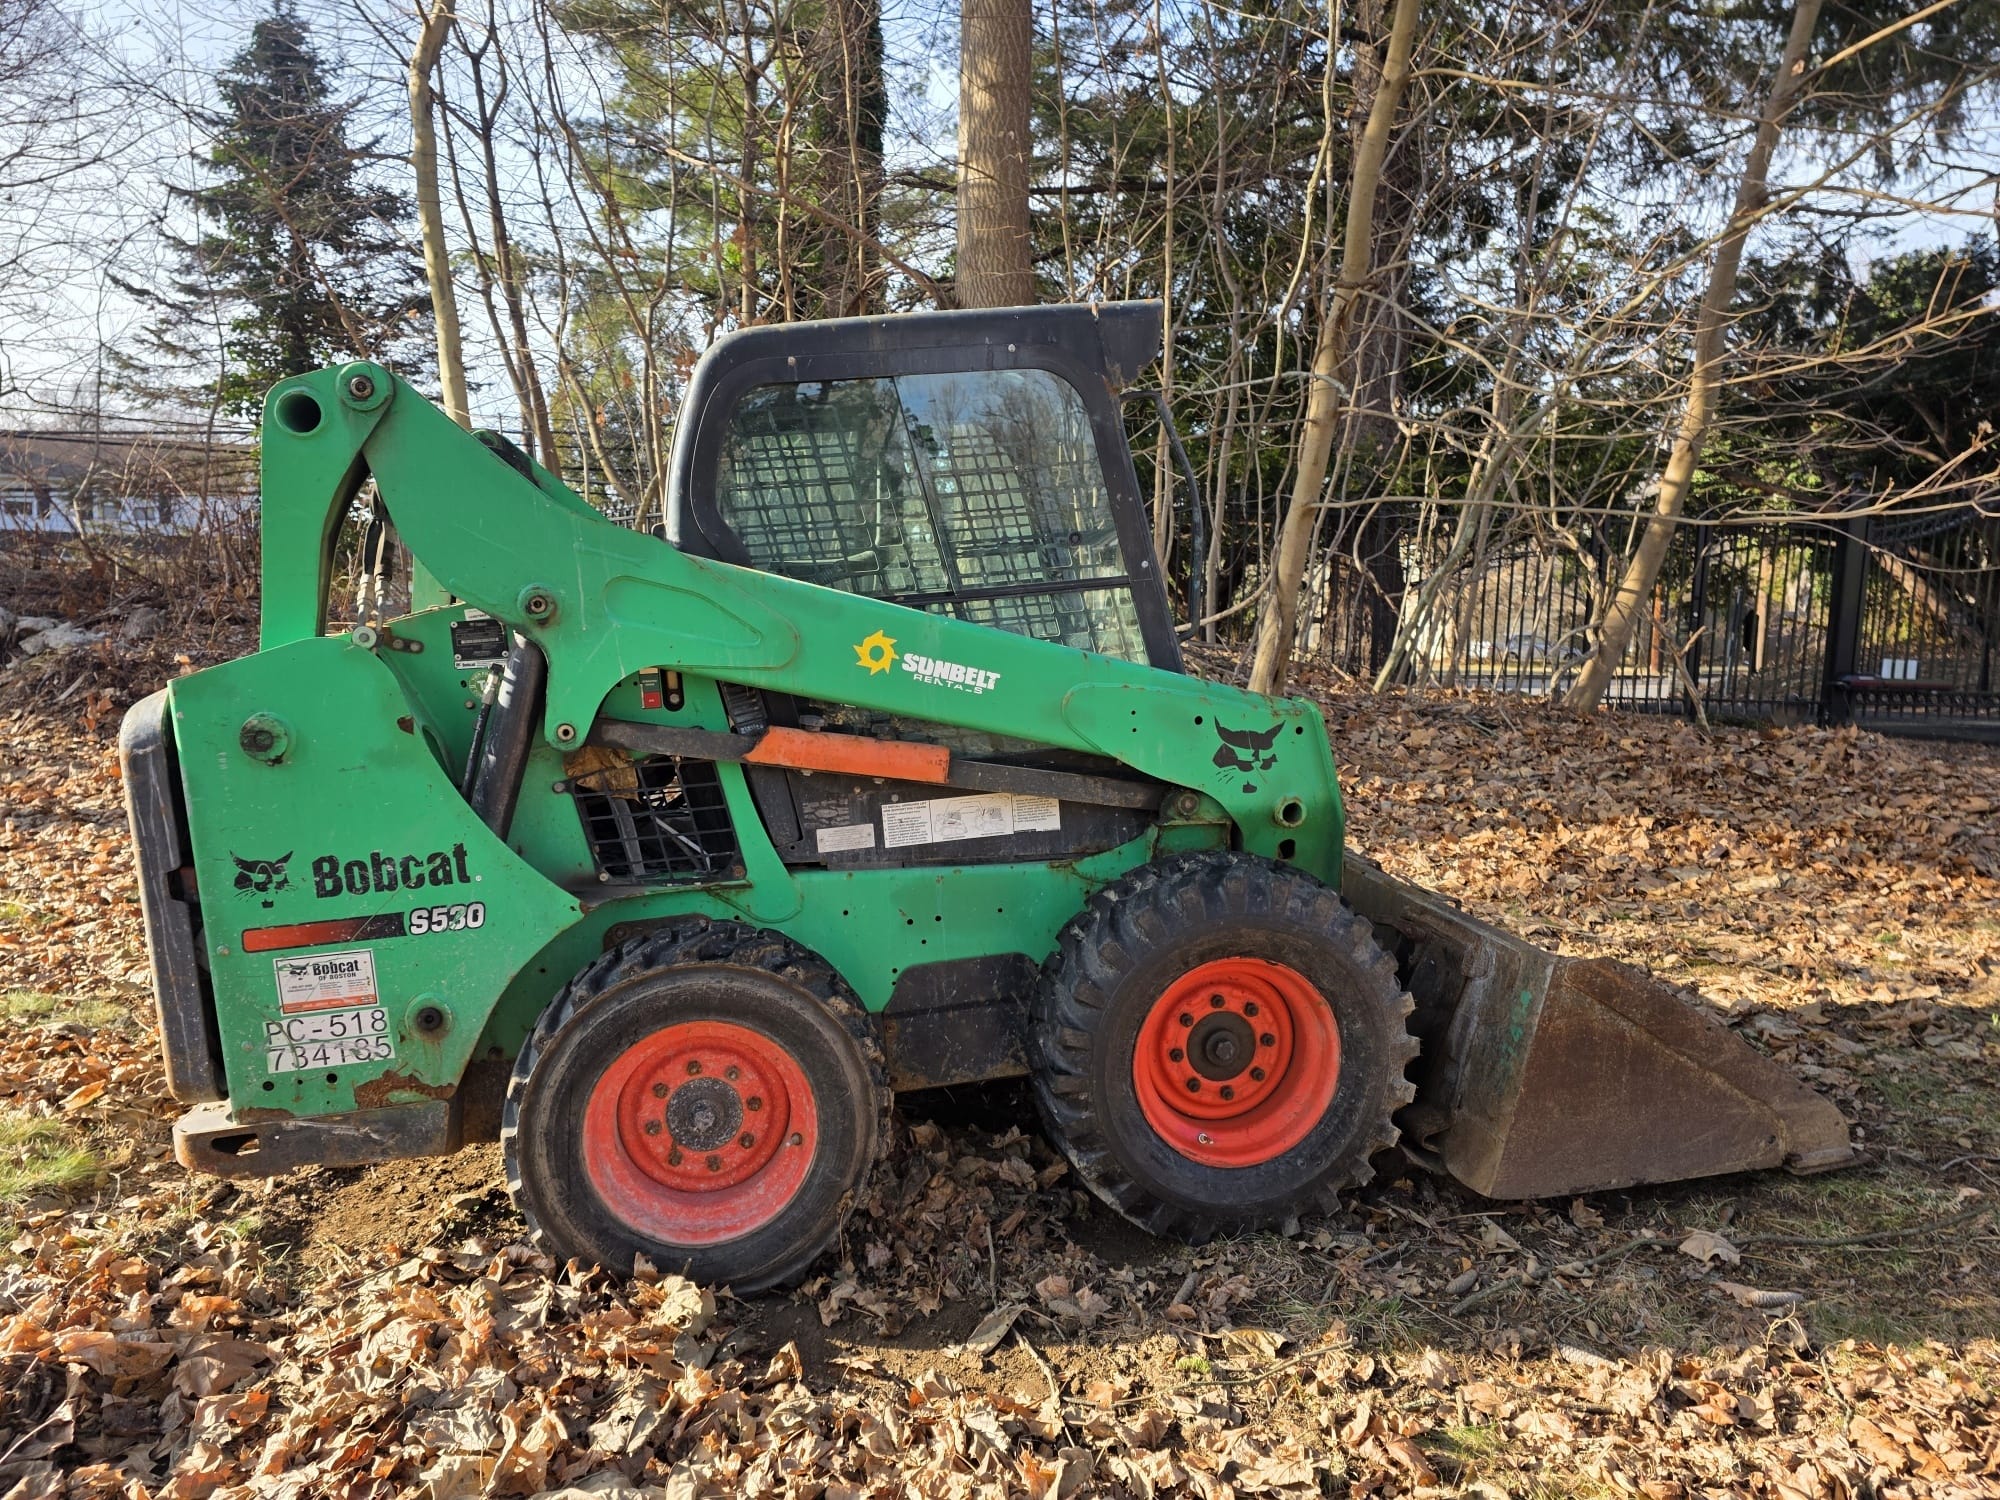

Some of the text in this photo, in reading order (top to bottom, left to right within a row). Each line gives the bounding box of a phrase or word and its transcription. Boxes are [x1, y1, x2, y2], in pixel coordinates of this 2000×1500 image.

[902, 653, 1001, 690] SUNBELT
[312, 843, 471, 899] Bobcat
[409, 901, 486, 936] S530
[313, 960, 360, 976] Bobcat
[329, 972, 357, 980] BOSTON
[265, 1009, 388, 1045] PC-518
